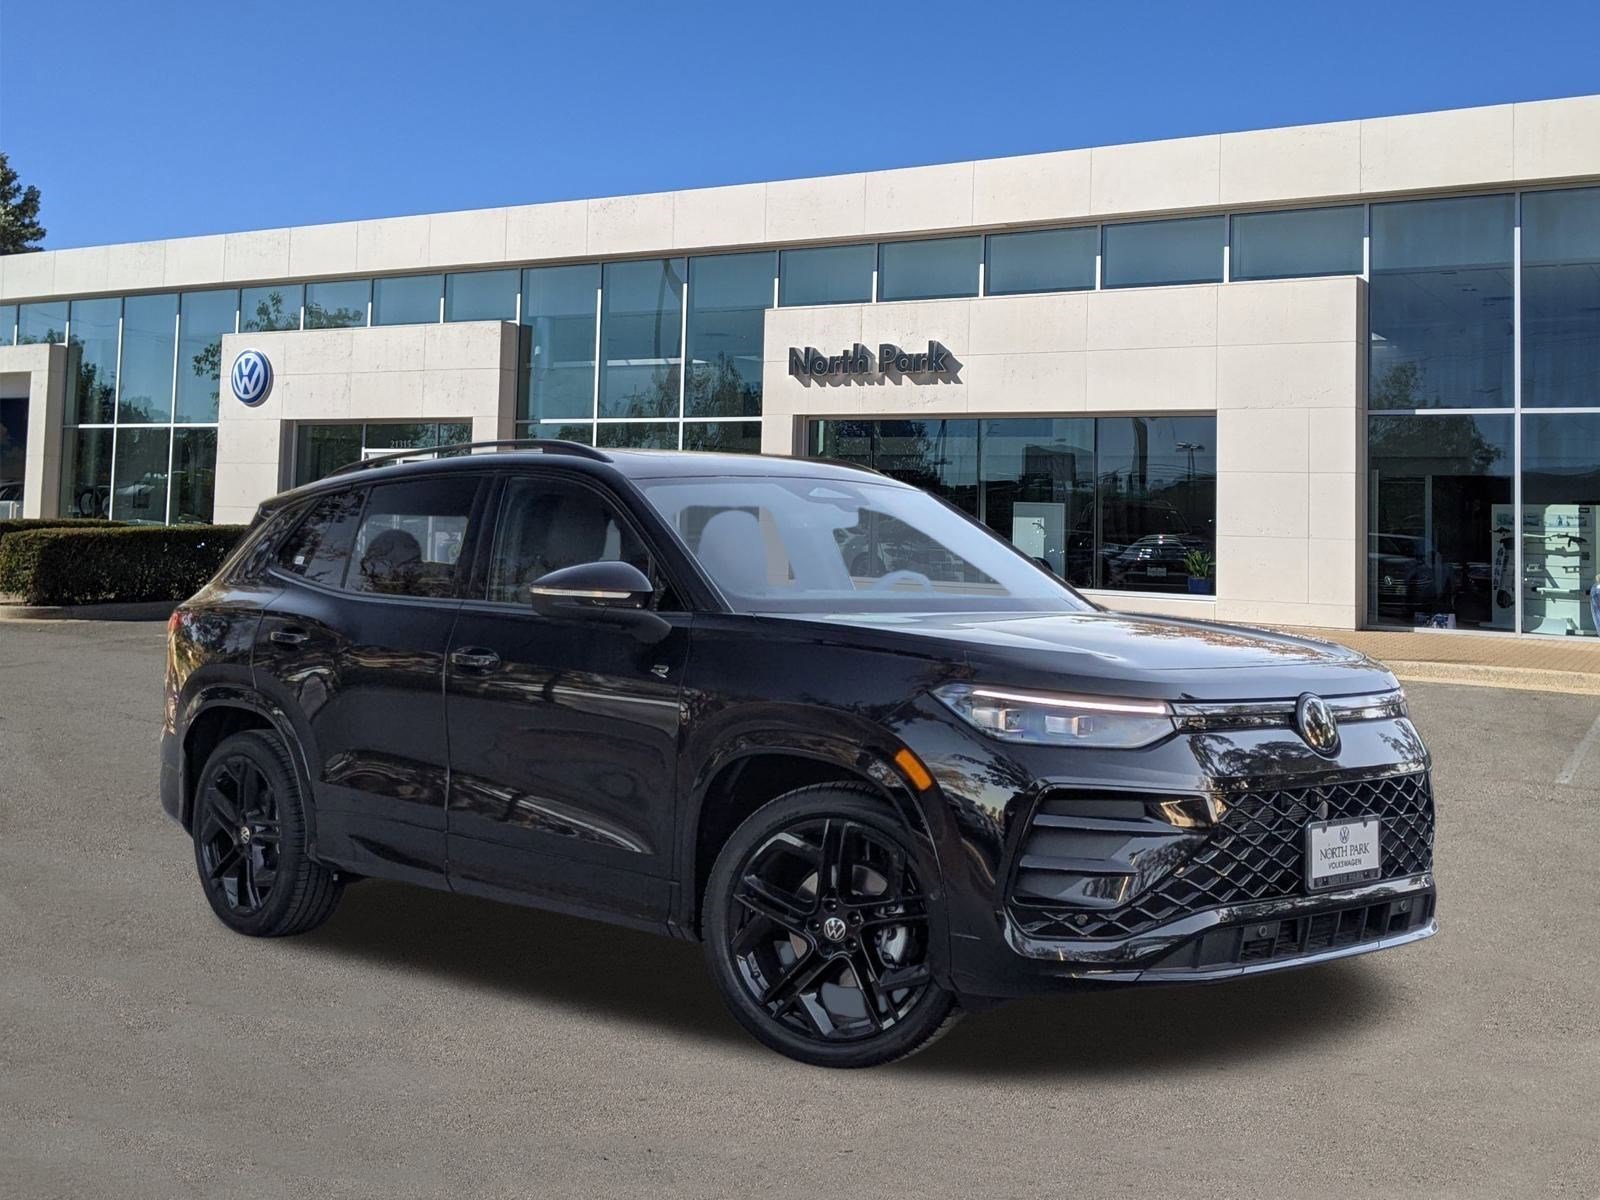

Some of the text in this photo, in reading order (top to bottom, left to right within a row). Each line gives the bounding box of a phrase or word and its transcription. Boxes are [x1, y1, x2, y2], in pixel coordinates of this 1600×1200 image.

[788, 340, 947, 376] North Park
[231, 350, 270, 404] VW
[1320, 842, 1370, 861] NORTH PARK
[1328, 858, 1362, 870] VOLKSWAGEN
[824, 917, 846, 941] VW
